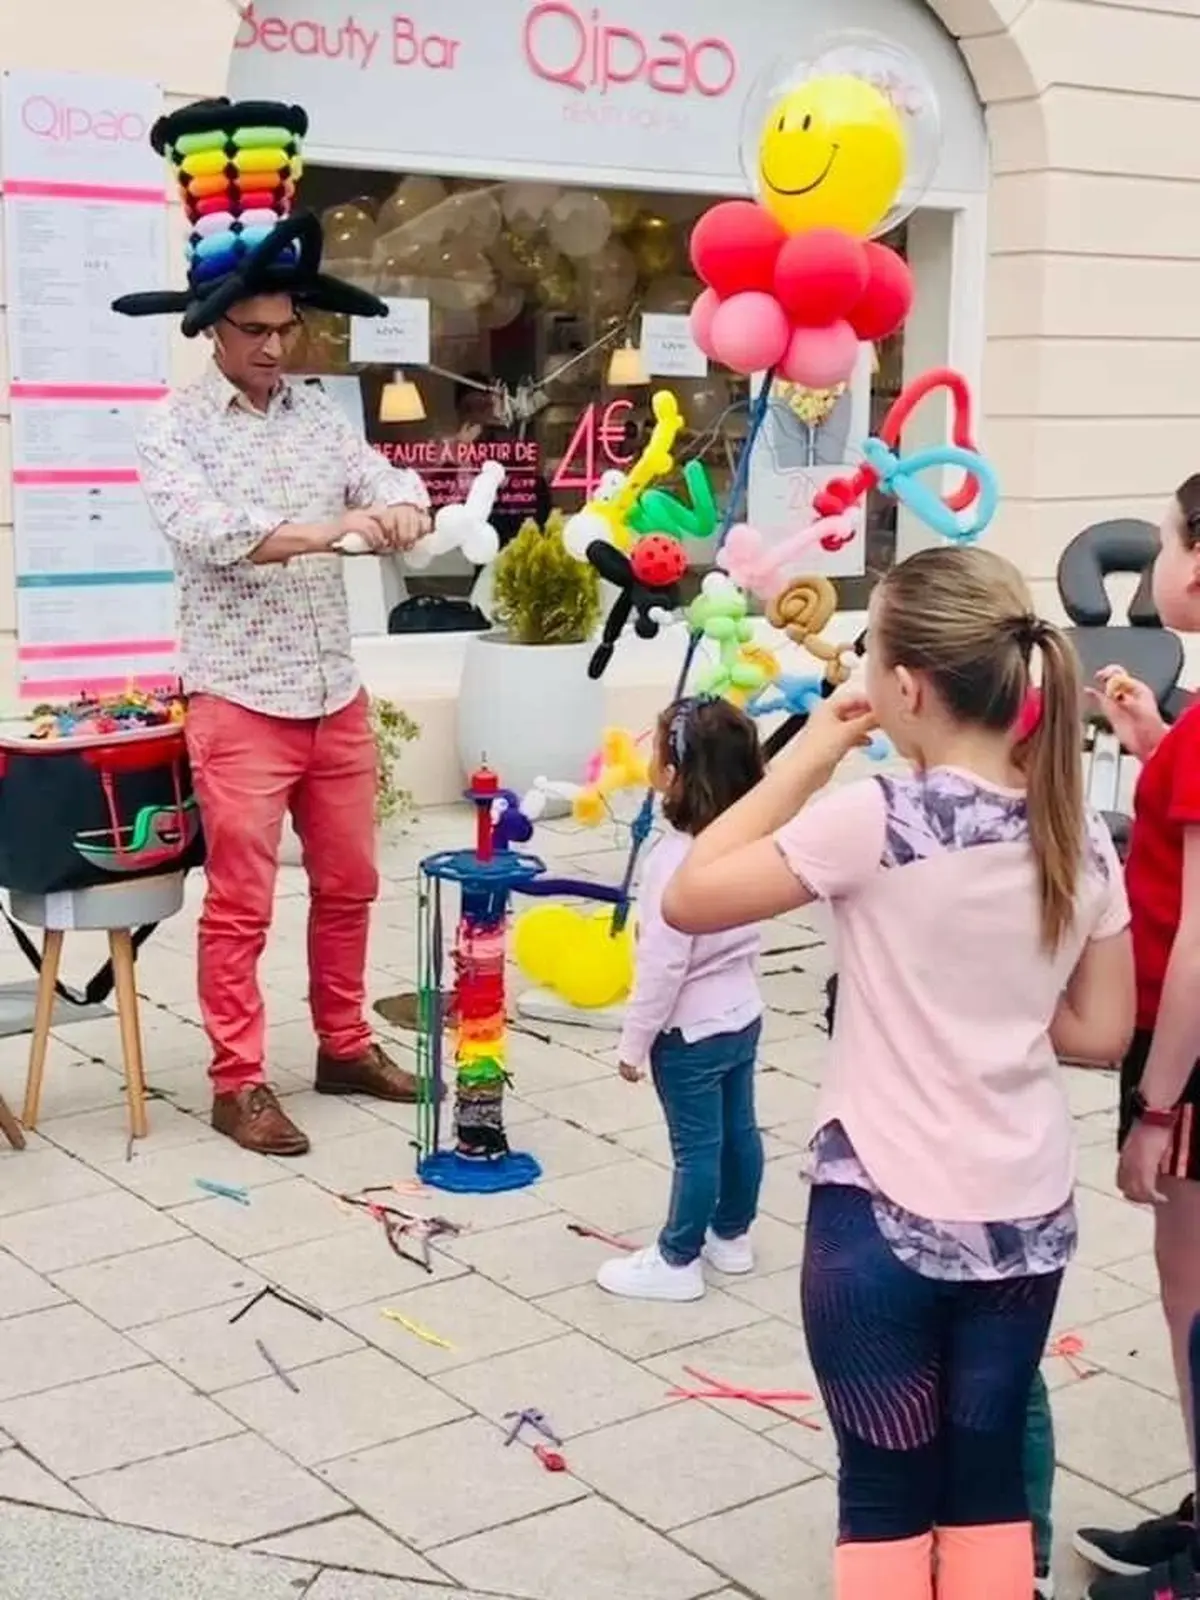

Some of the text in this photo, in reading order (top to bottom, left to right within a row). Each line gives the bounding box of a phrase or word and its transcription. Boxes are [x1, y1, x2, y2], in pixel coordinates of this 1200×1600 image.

[233, 3, 461, 70] Beauty Bar
[524, 1, 736, 97] Qipao
[21, 94, 147, 142] Qipao
[457, 442, 512, 463] PARTIR
[515, 442, 537, 462] DE
